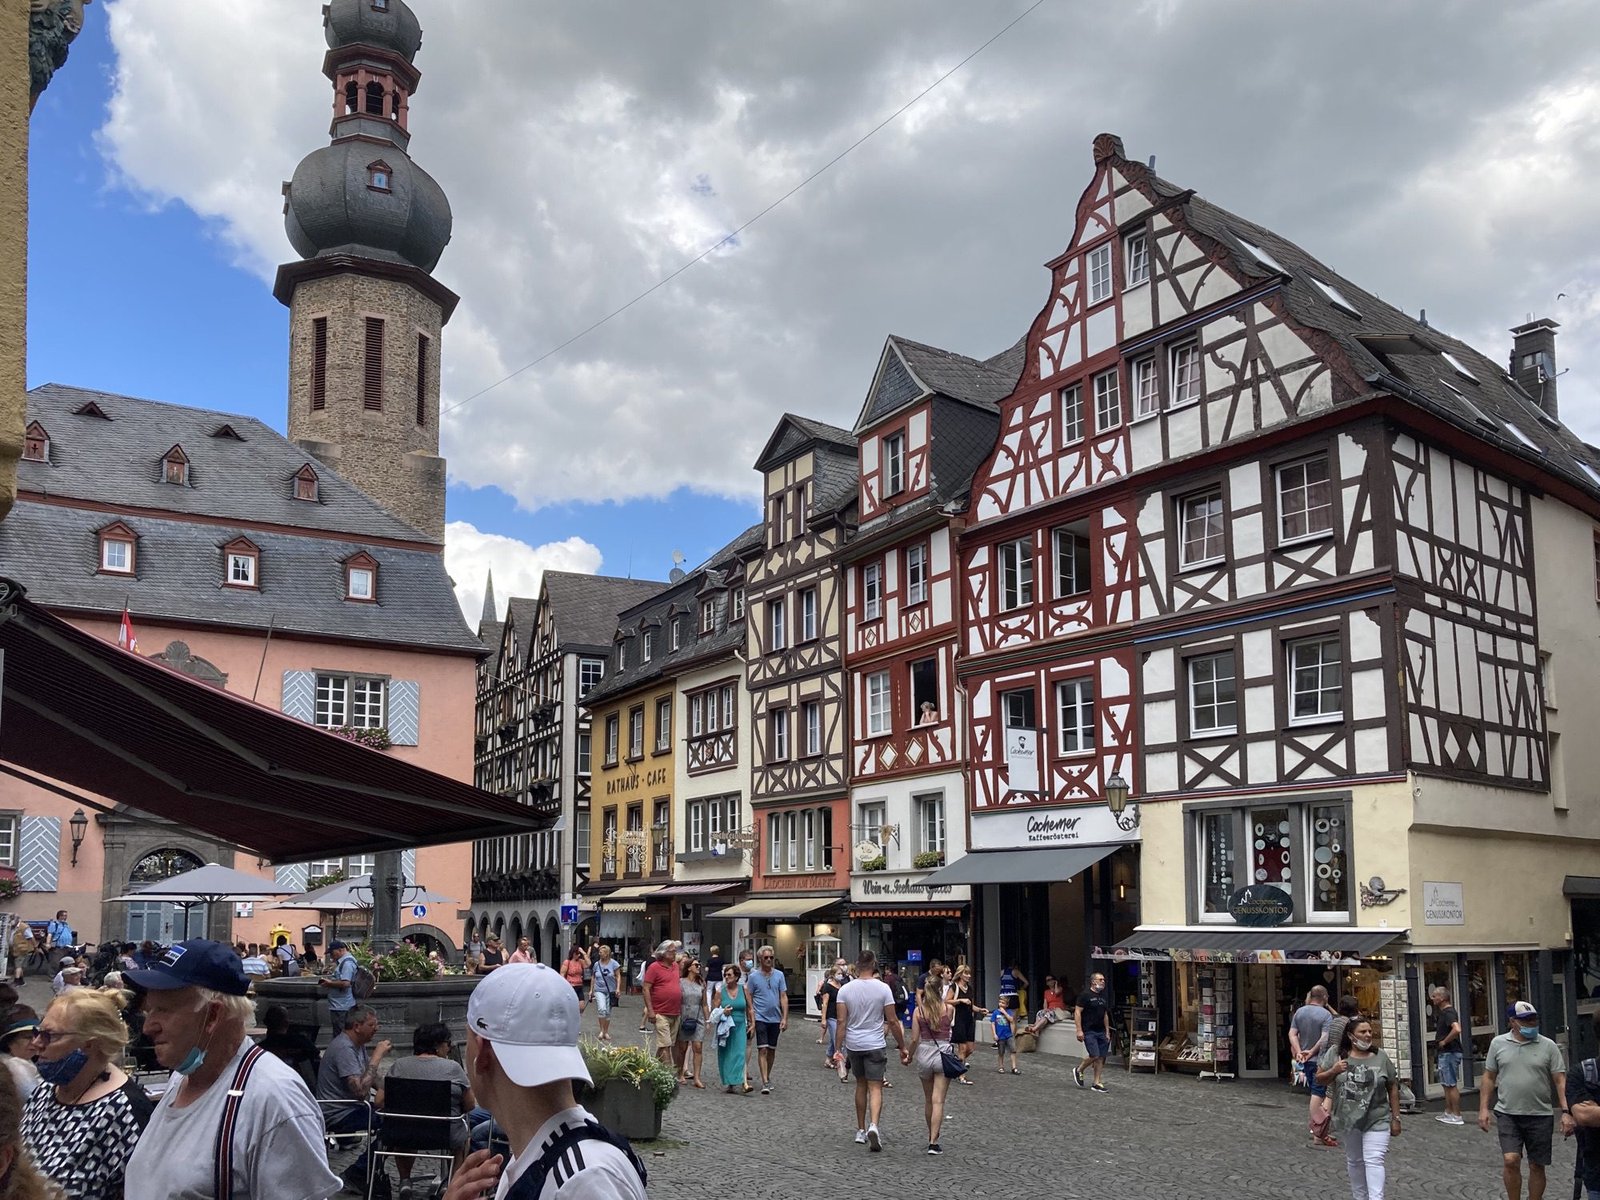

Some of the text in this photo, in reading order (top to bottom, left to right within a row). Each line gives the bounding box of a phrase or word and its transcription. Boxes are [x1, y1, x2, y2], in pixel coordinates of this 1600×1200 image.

[606, 767, 667, 795] RATHAUS CAFE
[1027, 814, 1081, 833] Cochemer
[1028, 832, 1079, 841] Kaffeerösterei
[808, 875, 837, 889] MARKT
[1233, 906, 1288, 914] GENUSSKONTOR
[1425, 909, 1463, 919] GENUSSKONTOR
